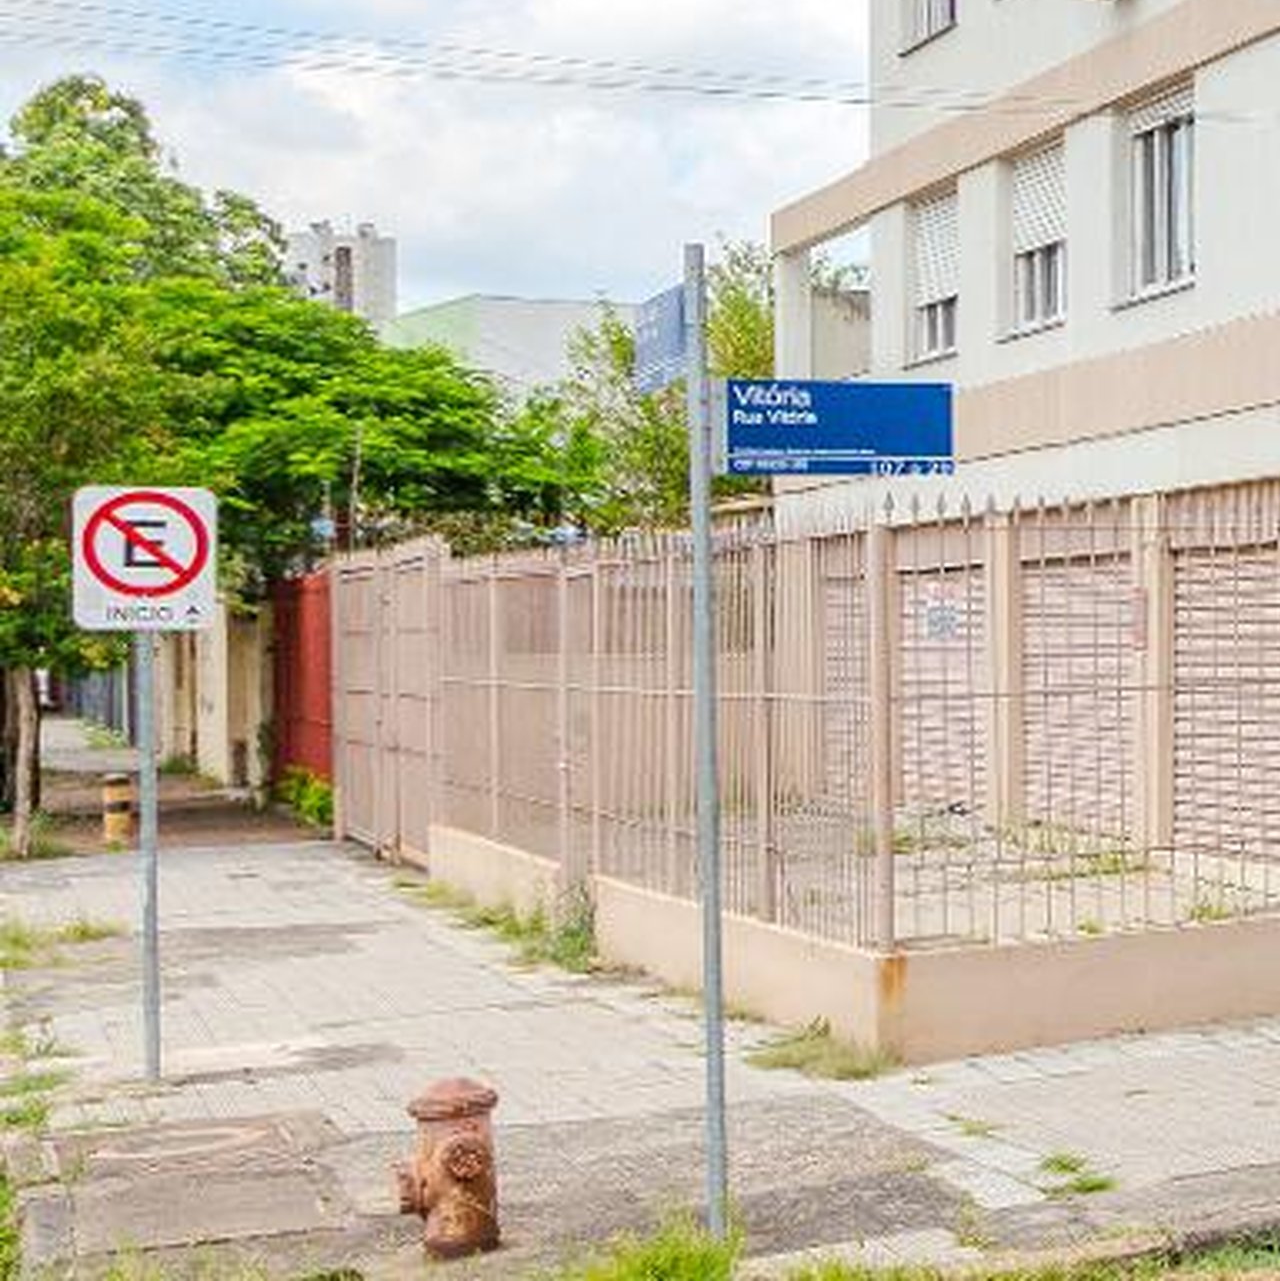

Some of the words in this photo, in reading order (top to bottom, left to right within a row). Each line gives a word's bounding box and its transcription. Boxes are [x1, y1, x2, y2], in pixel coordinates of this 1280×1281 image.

[732, 382, 812, 408] Vitória
[733, 409, 763, 424] Rua
[123, 520, 168, 568] E
